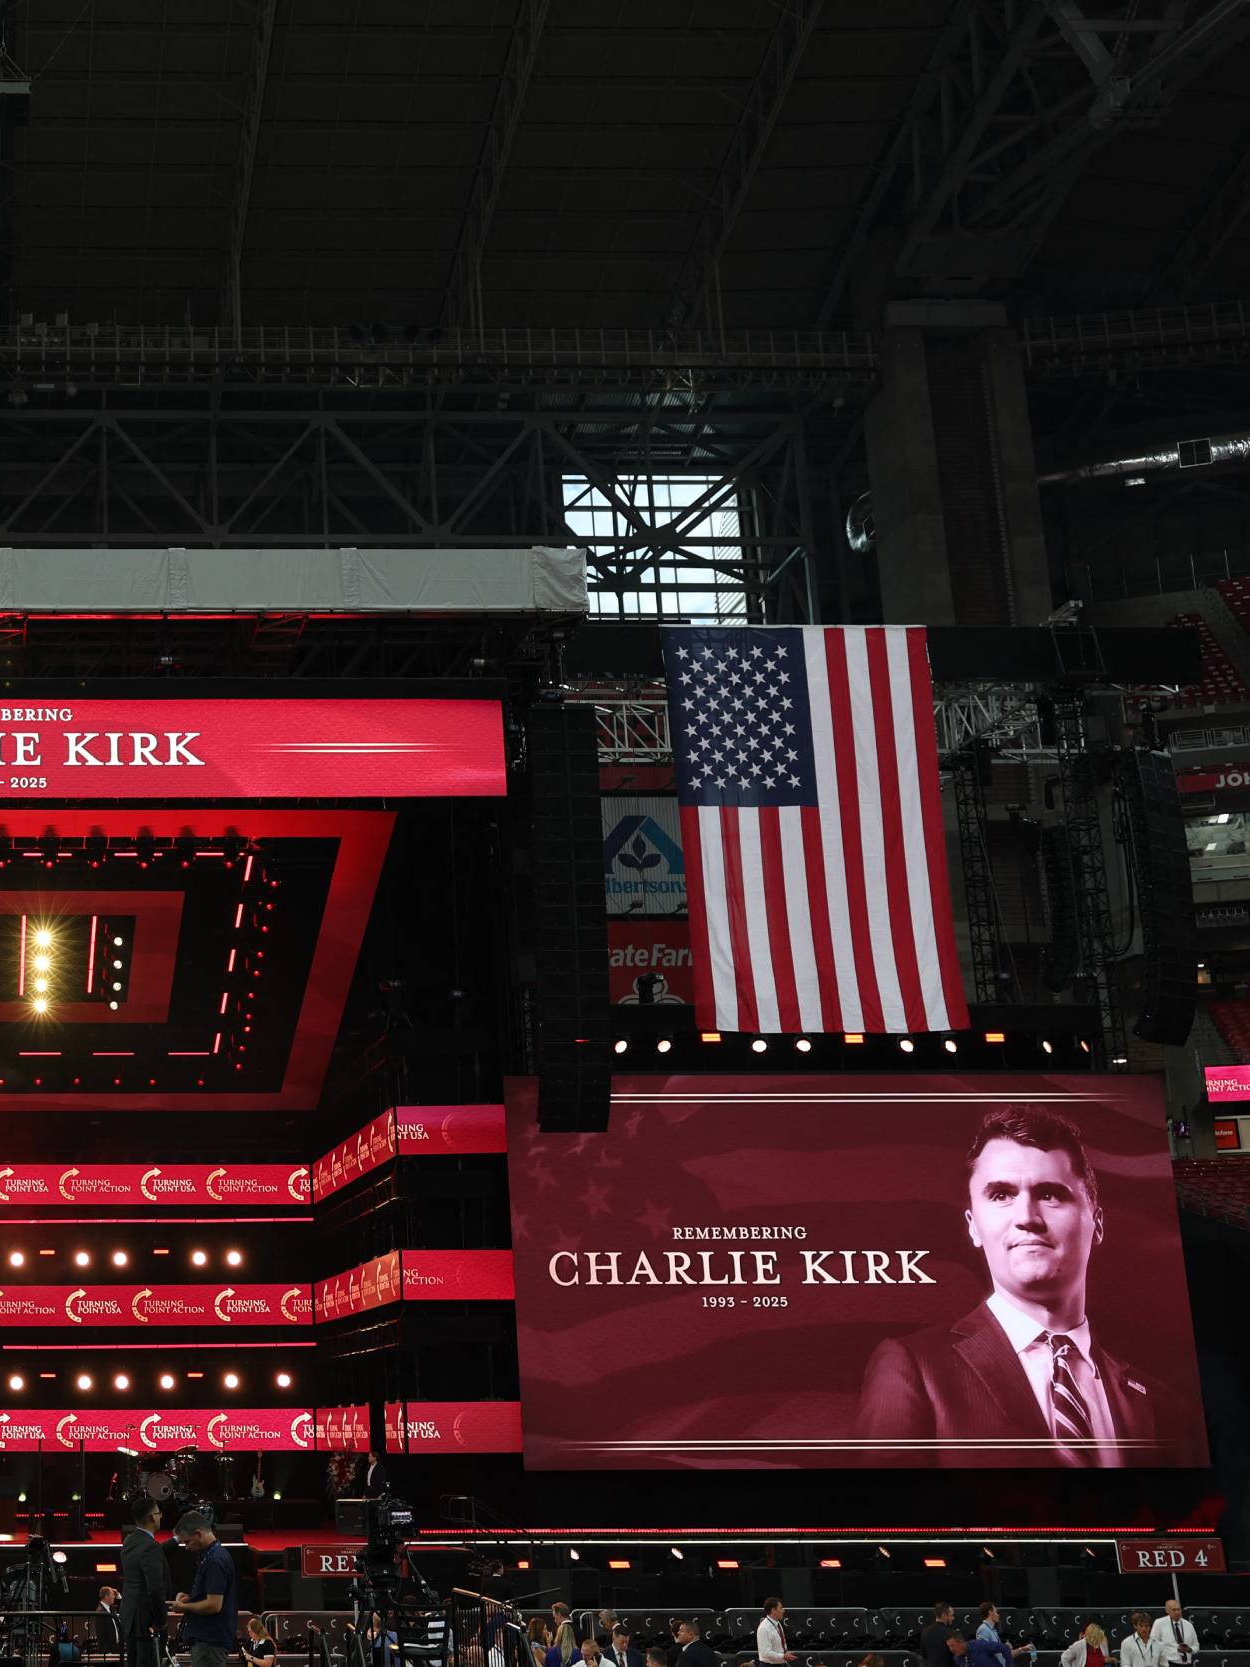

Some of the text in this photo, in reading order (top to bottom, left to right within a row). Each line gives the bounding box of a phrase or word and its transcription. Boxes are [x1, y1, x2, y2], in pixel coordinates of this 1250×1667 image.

[63, 732, 206, 766] KIRK
[11, 777, 47, 789] 2025
[606, 879, 687, 893] lbertson
[608, 943, 649, 967] ate
[397, 1124, 424, 1132] NING
[410, 1131, 430, 1140] USA
[672, 1226, 808, 1240] REMEMBERING
[548, 1250, 937, 1287] CHARLIE KIRK
[405, 1276, 444, 1285] ACTION
[78, 1300, 118, 1308] TURNING
[702, 1296, 735, 1308] 1993
[753, 1296, 788, 1308] 2025
[407, 1421, 435, 1430] NING
[422, 1430, 441, 1438] USA
[319, 1555, 358, 1572] RE
[1136, 1549, 1209, 1568] RED 4
